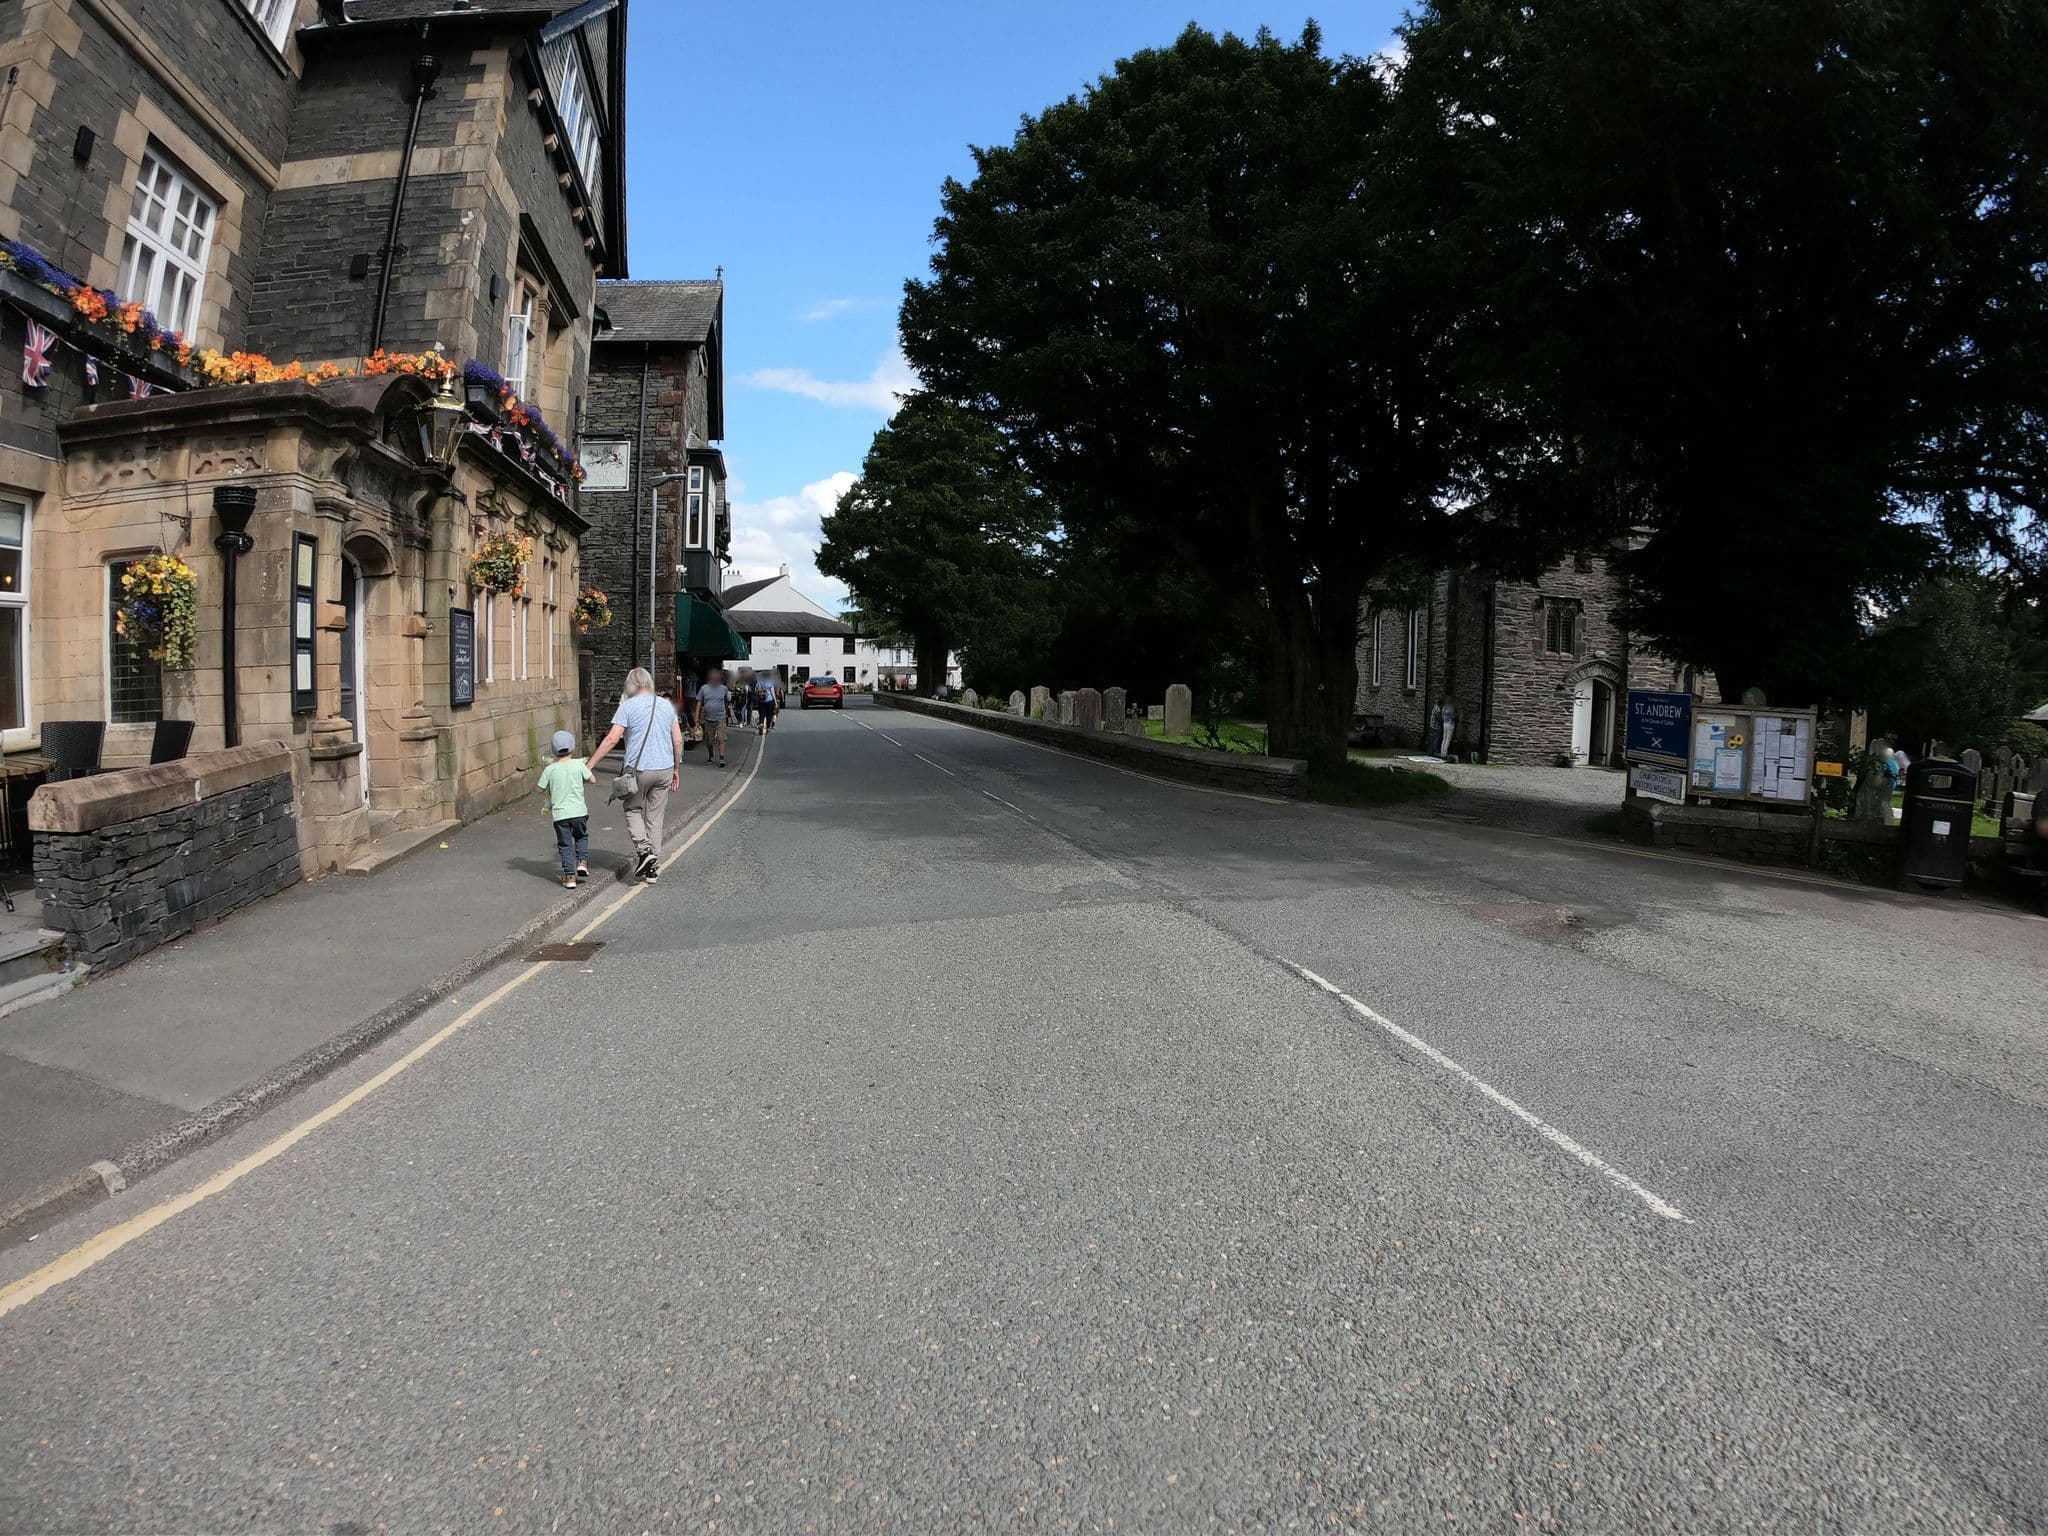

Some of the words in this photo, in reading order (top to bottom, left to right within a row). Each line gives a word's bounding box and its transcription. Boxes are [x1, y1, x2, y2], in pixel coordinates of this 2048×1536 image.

[1635, 702, 1645, 715] ST.
[1646, 704, 1682, 719] ANDREW
[1653, 784, 1678, 796] WELCOME
